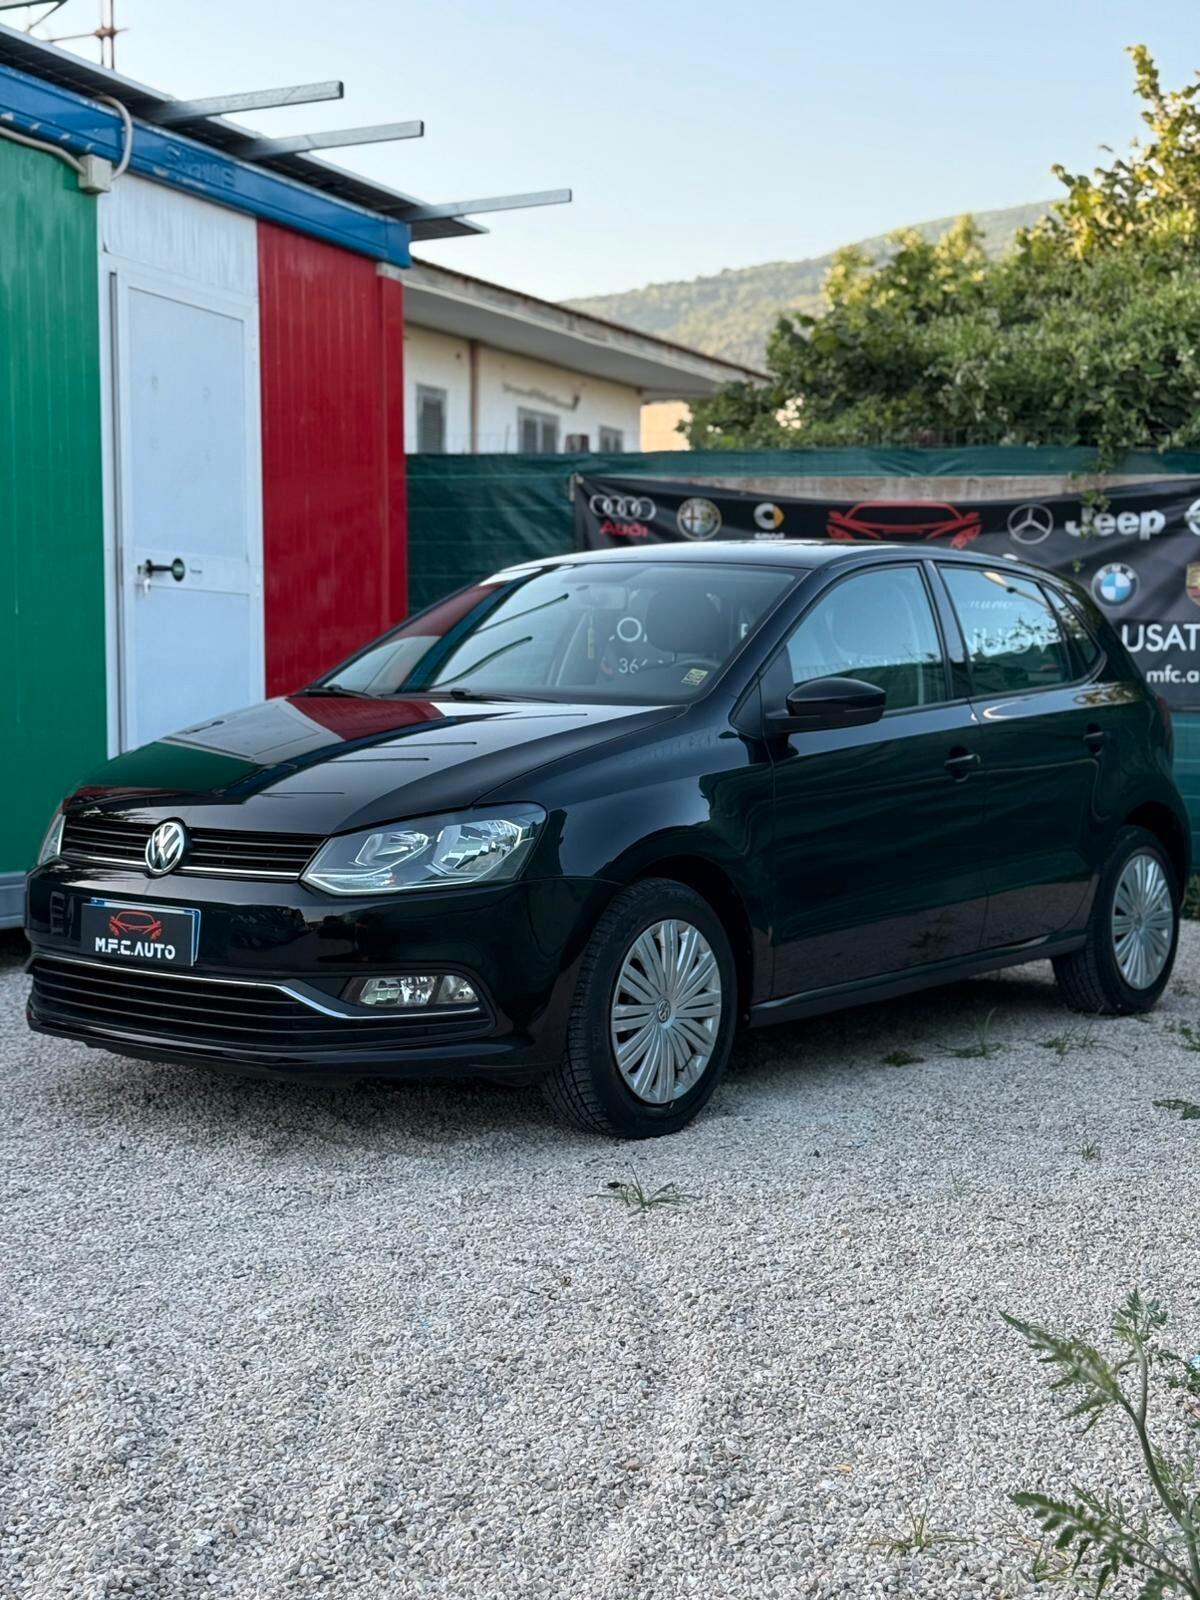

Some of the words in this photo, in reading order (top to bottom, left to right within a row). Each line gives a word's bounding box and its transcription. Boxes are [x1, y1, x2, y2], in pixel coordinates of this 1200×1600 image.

[601, 520, 649, 537] Audi
[1065, 508, 1166, 540] Jeep
[1121, 624, 1200, 652] USAT
[1146, 664, 1200, 683] mfc.a
